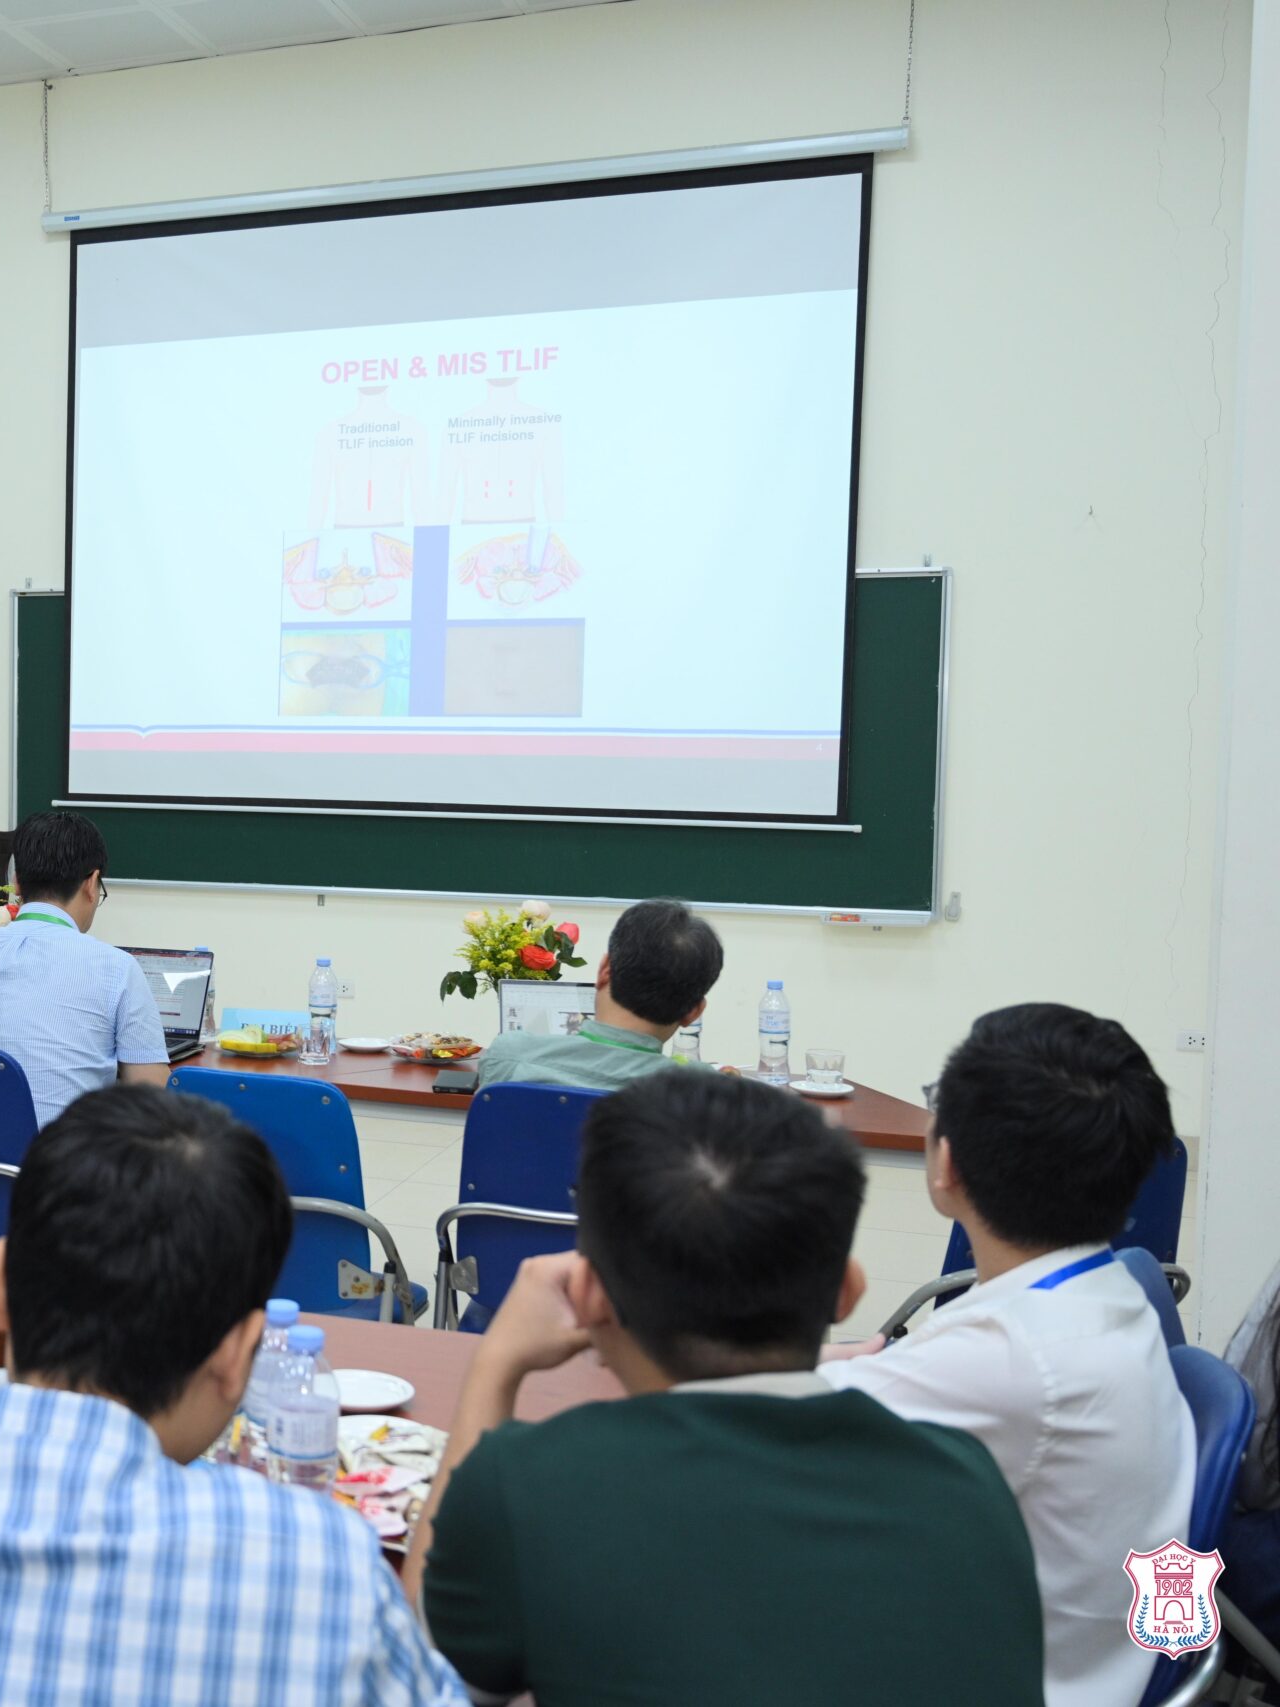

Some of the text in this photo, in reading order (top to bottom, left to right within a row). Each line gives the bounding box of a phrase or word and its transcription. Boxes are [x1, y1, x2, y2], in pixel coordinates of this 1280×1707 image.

[321, 346, 559, 384] OPEN & MIS TLIF
[338, 420, 401, 435] Traditional
[447, 412, 562, 430] Minimally invasive
[338, 436, 414, 450] TLIF incision
[447, 429, 535, 444] TLIF incisions
